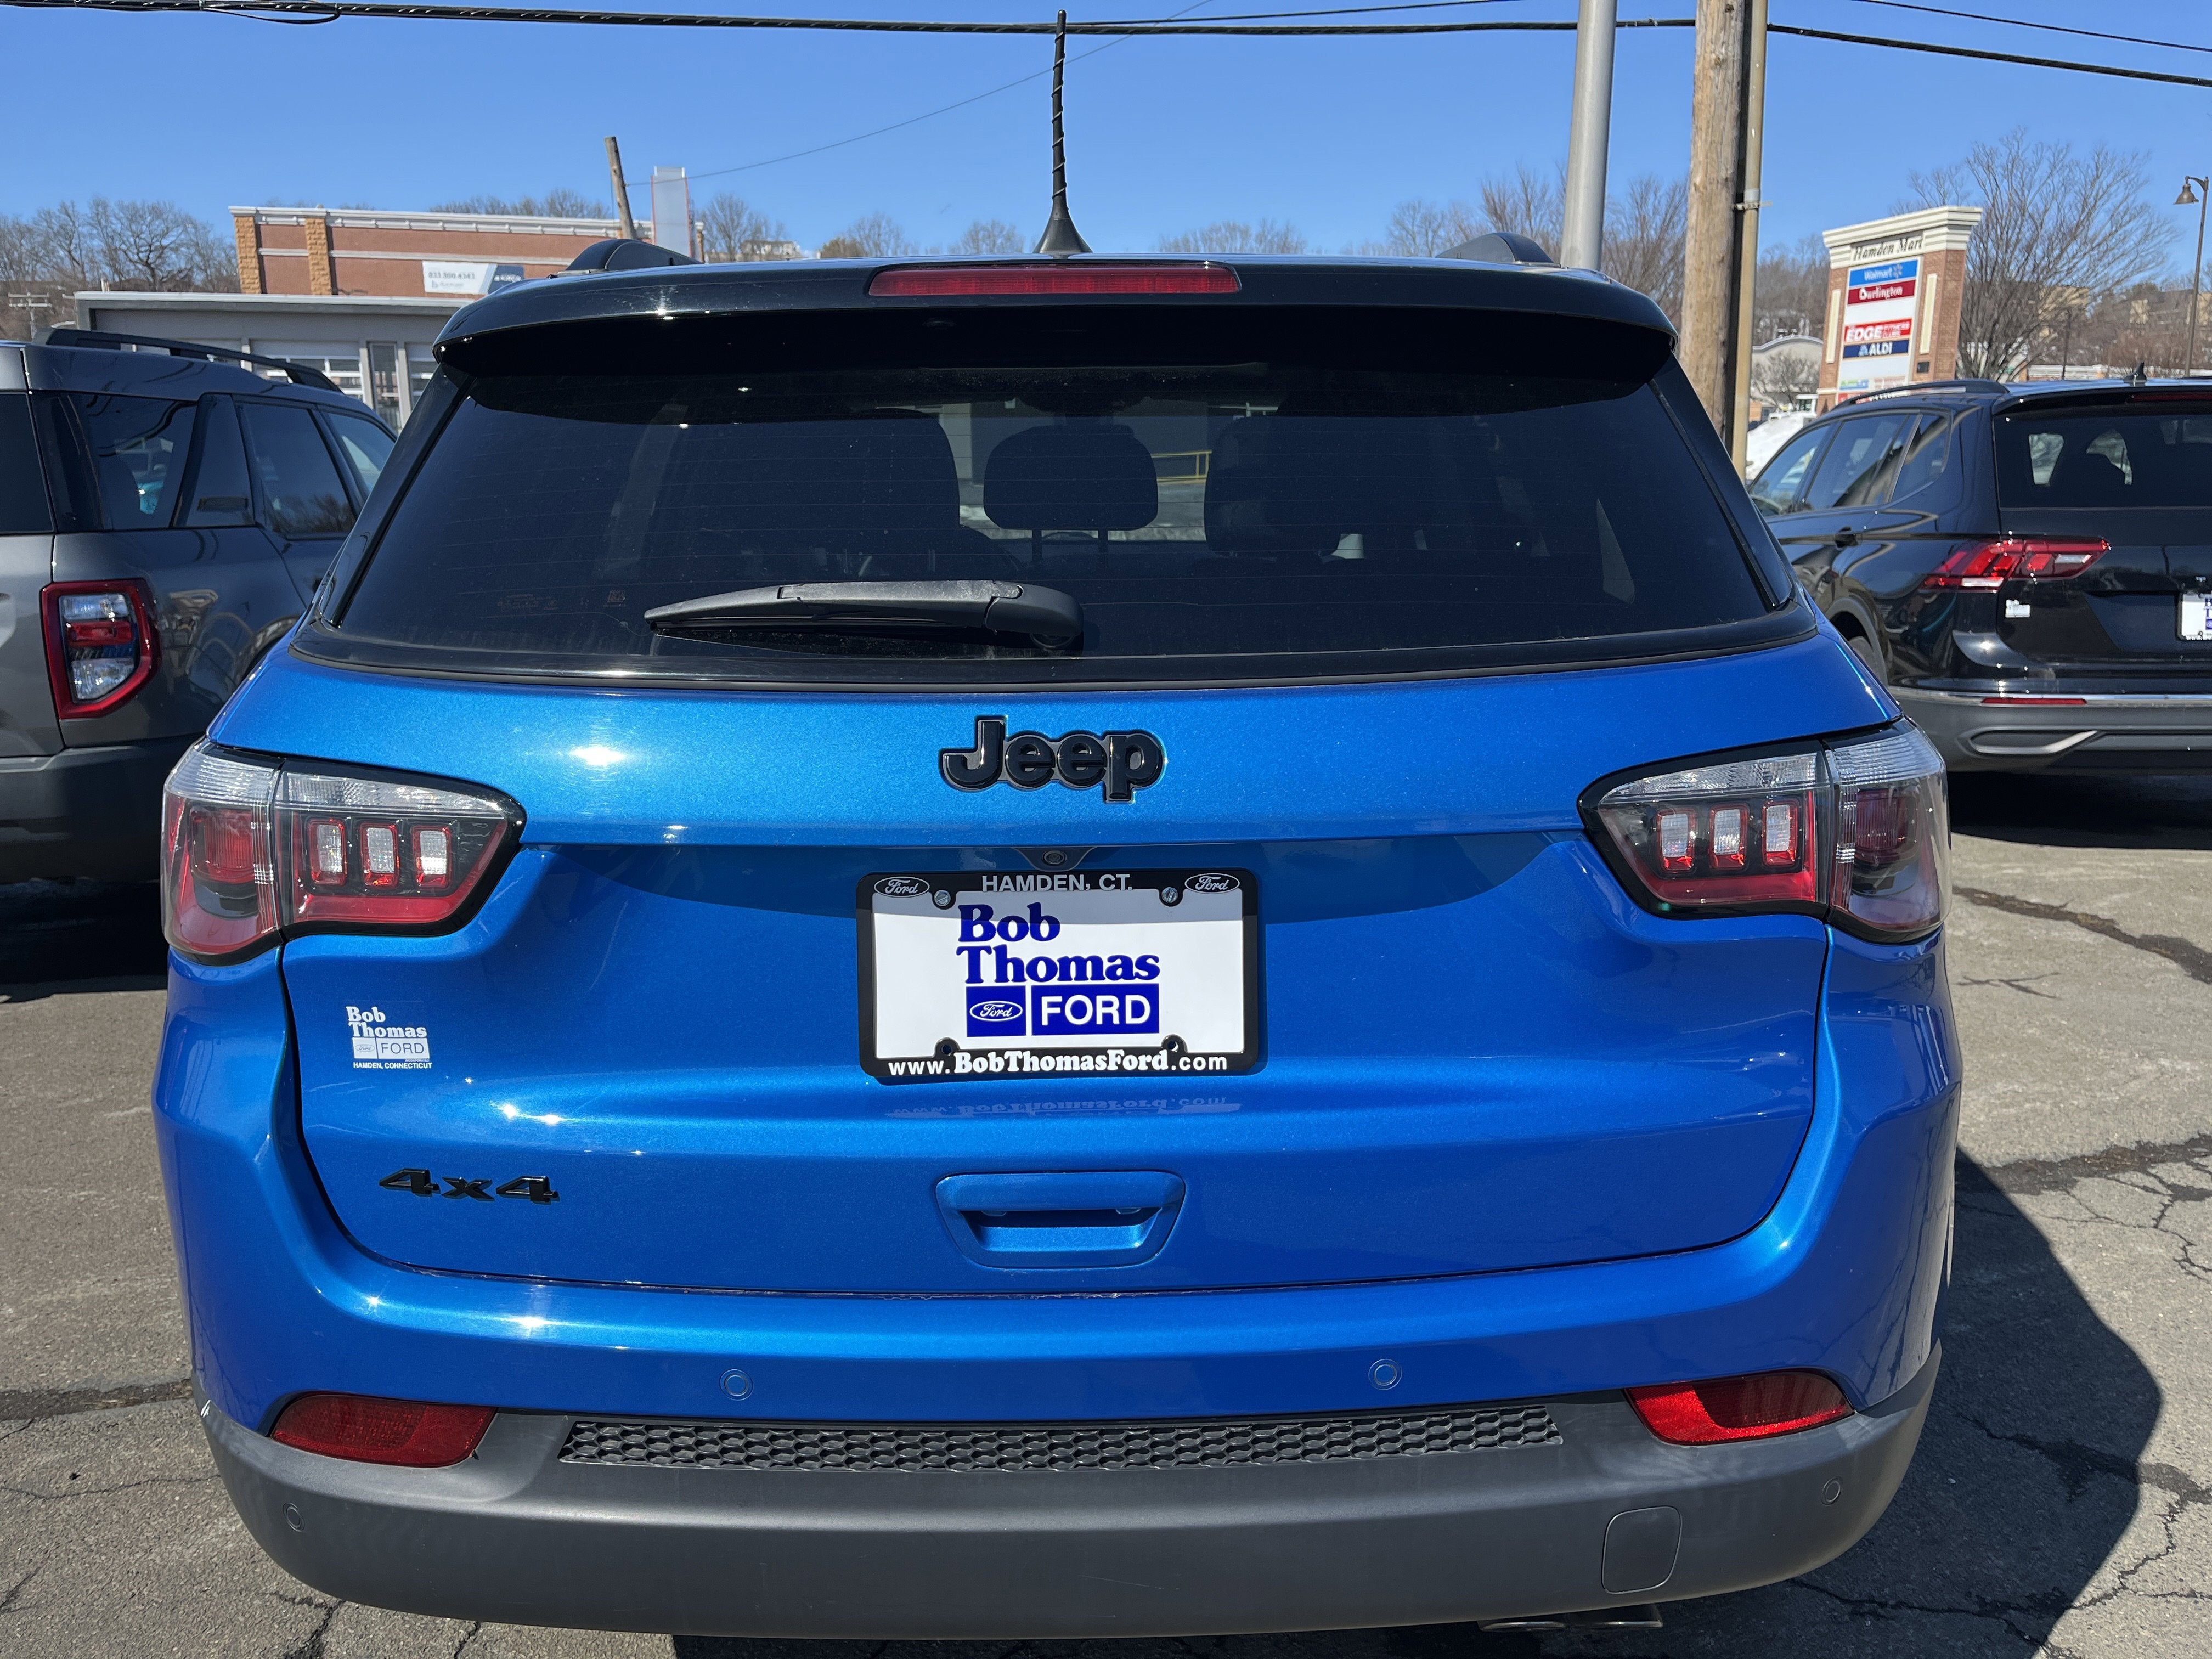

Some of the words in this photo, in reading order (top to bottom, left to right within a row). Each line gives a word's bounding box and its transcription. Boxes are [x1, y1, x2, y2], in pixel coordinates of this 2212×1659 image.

[1854, 242, 1894, 261] Hamden
[1898, 237, 1922, 253] Mart
[1864, 267, 1892, 280] Walmart
[1859, 286, 1903, 300] Burlington
[1847, 326, 1882, 342] EDGE
[1869, 342, 1893, 356] ALDI
[939, 715, 1167, 804] Jeep
[885, 879, 918, 894] Ford
[982, 874, 1091, 893] HAMDEN,
[1099, 874, 1132, 891] CT.
[1195, 876, 1228, 891] Ford
[958, 902, 1060, 941] Bob
[956, 945, 1160, 983] Thomas
[346, 1007, 386, 1022] Bob
[980, 1003, 1013, 1017] Ford
[1041, 994, 1151, 1025] FORD
[348, 1022, 427, 1037] Thomas
[381, 1042, 424, 1054] FORD
[889, 1050, 1227, 1076] www.BobThomasFord.com
[379, 1167, 560, 1205] 4x4
